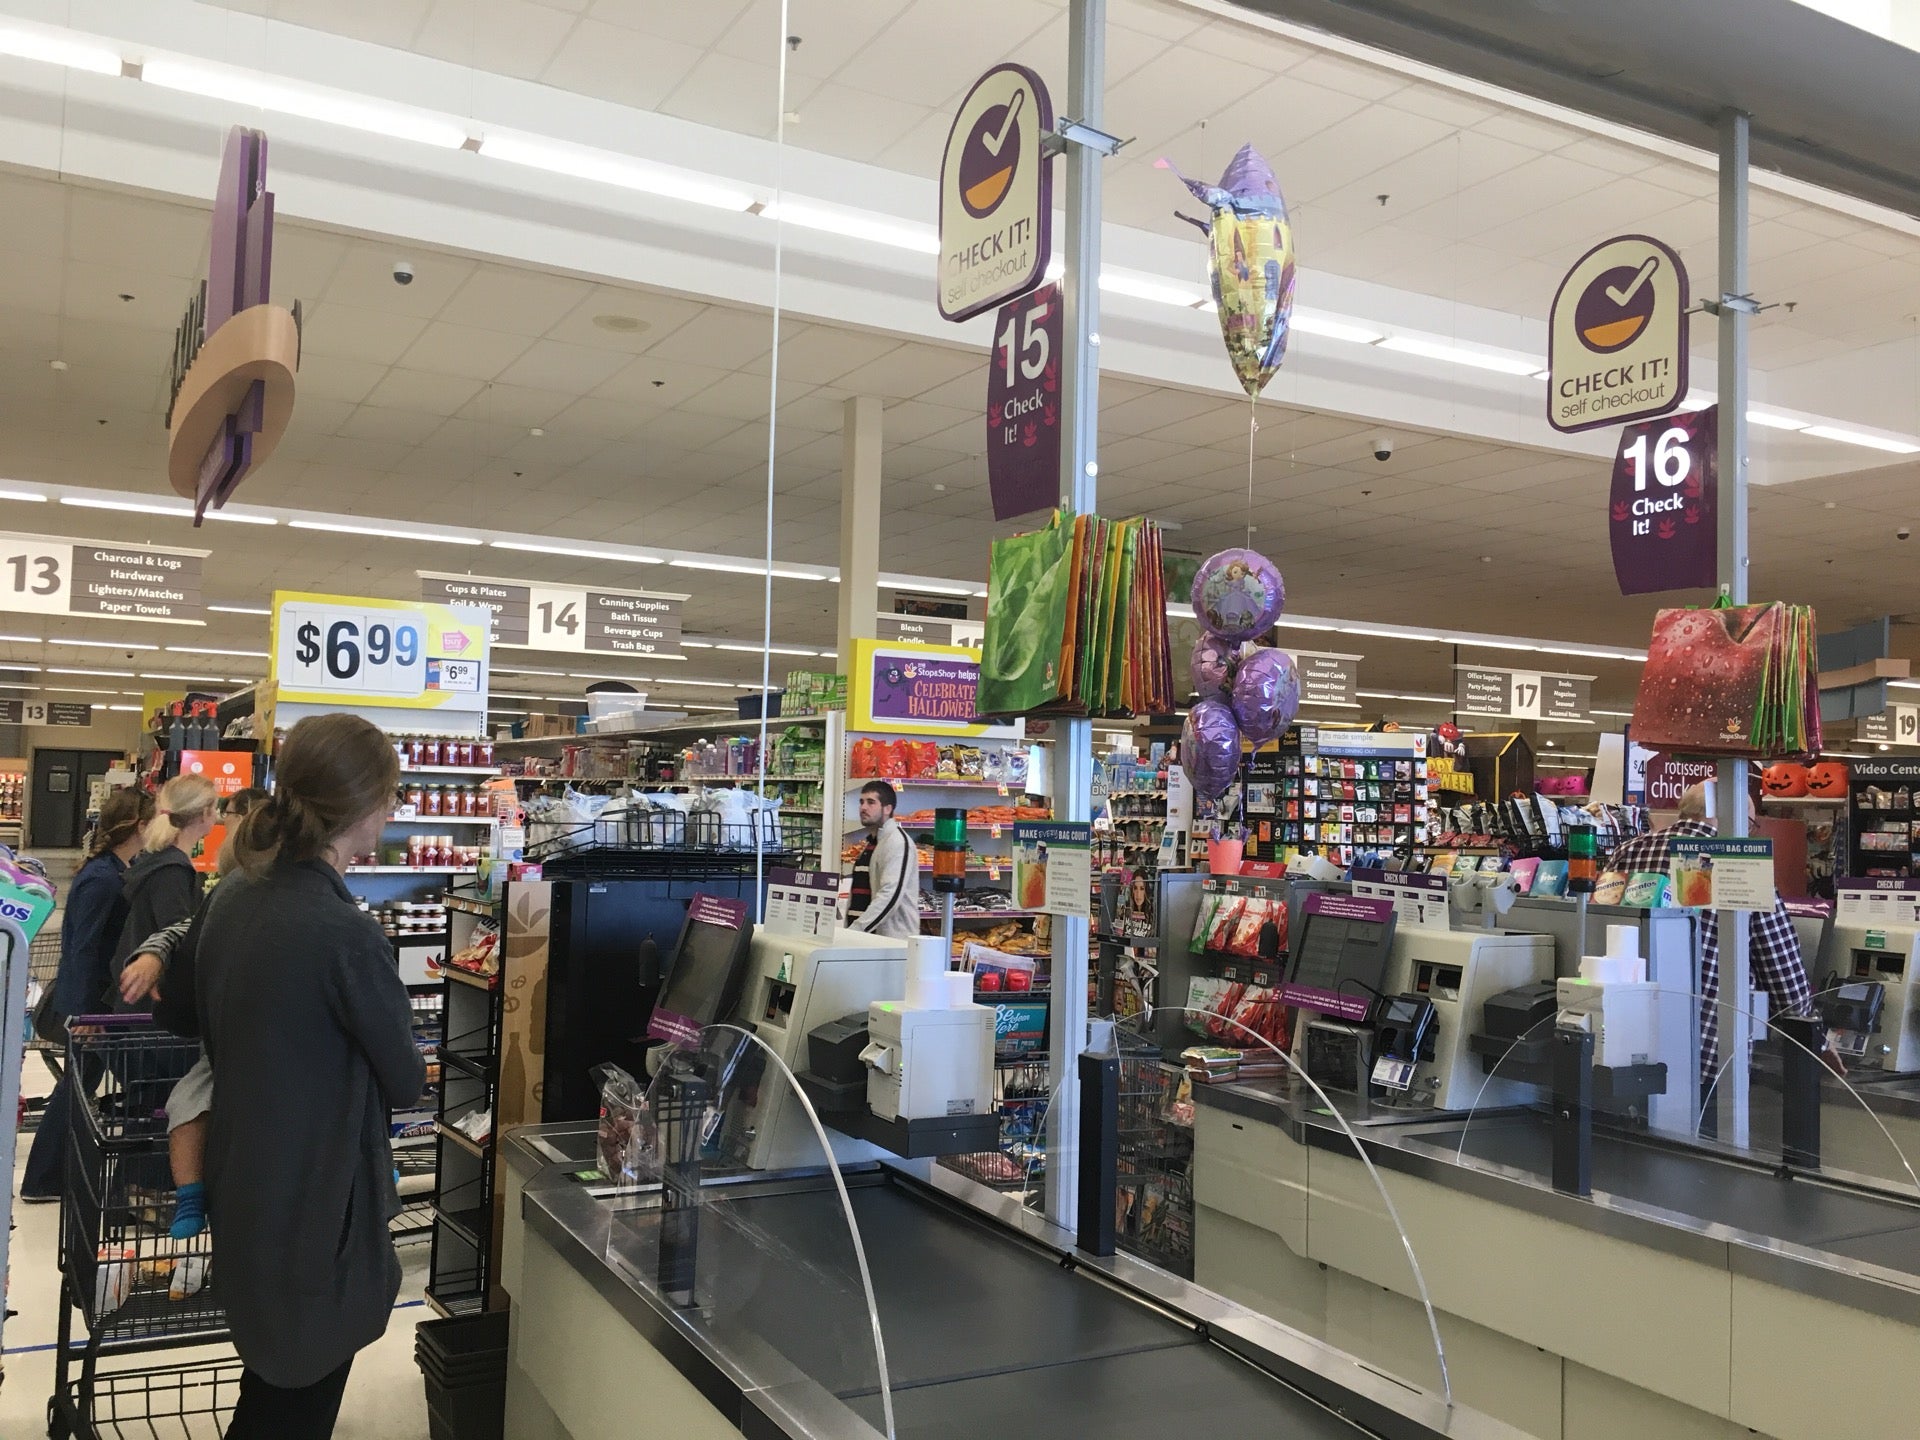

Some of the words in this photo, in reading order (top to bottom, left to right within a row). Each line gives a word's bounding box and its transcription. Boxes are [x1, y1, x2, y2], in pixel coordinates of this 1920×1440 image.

[1009, 217, 1030, 248] IT!
[999, 303, 1049, 388] 15
[1560, 365, 1634, 398] CHECK
[1642, 358, 1668, 380] IT!
[1004, 388, 1044, 420] Check
[1561, 397, 1587, 418] self
[1591, 382, 1665, 412] checkout
[1004, 424, 1017, 445] It!
[1624, 428, 1691, 492] 16
[1632, 493, 1684, 516] Check
[1633, 519, 1650, 536] It!
[94, 552, 142, 564] Charcoal
[146, 556, 154, 566] &
[158, 558, 182, 570] Logs
[8, 554, 60, 596] 13
[110, 569, 164, 582] Hardware
[88, 584, 184, 600] Lighters/Matches
[446, 584, 468, 596] Cups
[480, 587, 506, 597] Plates
[100, 601, 132, 613] Paper
[134, 604, 171, 616] Towels
[479, 602, 503, 613] Wrap
[600, 598, 634, 610] Canning
[636, 601, 670, 612] Supplies
[537, 601, 580, 635] 14
[611, 612, 630, 622] Bath
[632, 614, 658, 624] Tissue
[604, 626, 641, 638] Beverage
[642, 629, 663, 639] Cups
[900, 624, 924, 632] Bleach
[612, 640, 634, 650] Trash
[636, 643, 655, 652] Bags
[1315, 660, 1338, 668] Seasonal
[958, 670, 976, 681] helps
[1306, 670, 1330, 678] Seasonal
[1330, 672, 1346, 680] Candy
[1467, 672, 1482, 680] Office
[1482, 674, 1502, 682] Supplies
[914, 680, 976, 700] CELEBRATE
[1306, 681, 1330, 689] Seasonal
[1482, 684, 1500, 692] Supplies
[1308, 692, 1330, 700] Seasonal
[1330, 694, 1346, 702] Items
[1488, 695, 1502, 704] Candy
[1516, 684, 1538, 708] 17
[1554, 690, 1576, 698] Magazines
[1556, 700, 1574, 708] Seasonal
[26, 706, 44, 719] 13
[1899, 715, 1916, 736] 19
[1427, 757, 1454, 773] PPY
[1664, 760, 1714, 778] rotisserie
[1854, 764, 1888, 774] Video
[1890, 764, 1920, 774] Cent
[1651, 774, 1690, 800] chick
[1019, 829, 1038, 838] MAKE
[1058, 830, 1070, 840] BAG
[1071, 832, 1088, 840] COUNT
[1384, 872, 1398, 883] CHECK
[1399, 874, 1408, 884] OUT
[1876, 880, 1894, 889] CHECK
[1894, 880, 1904, 889] OUT
